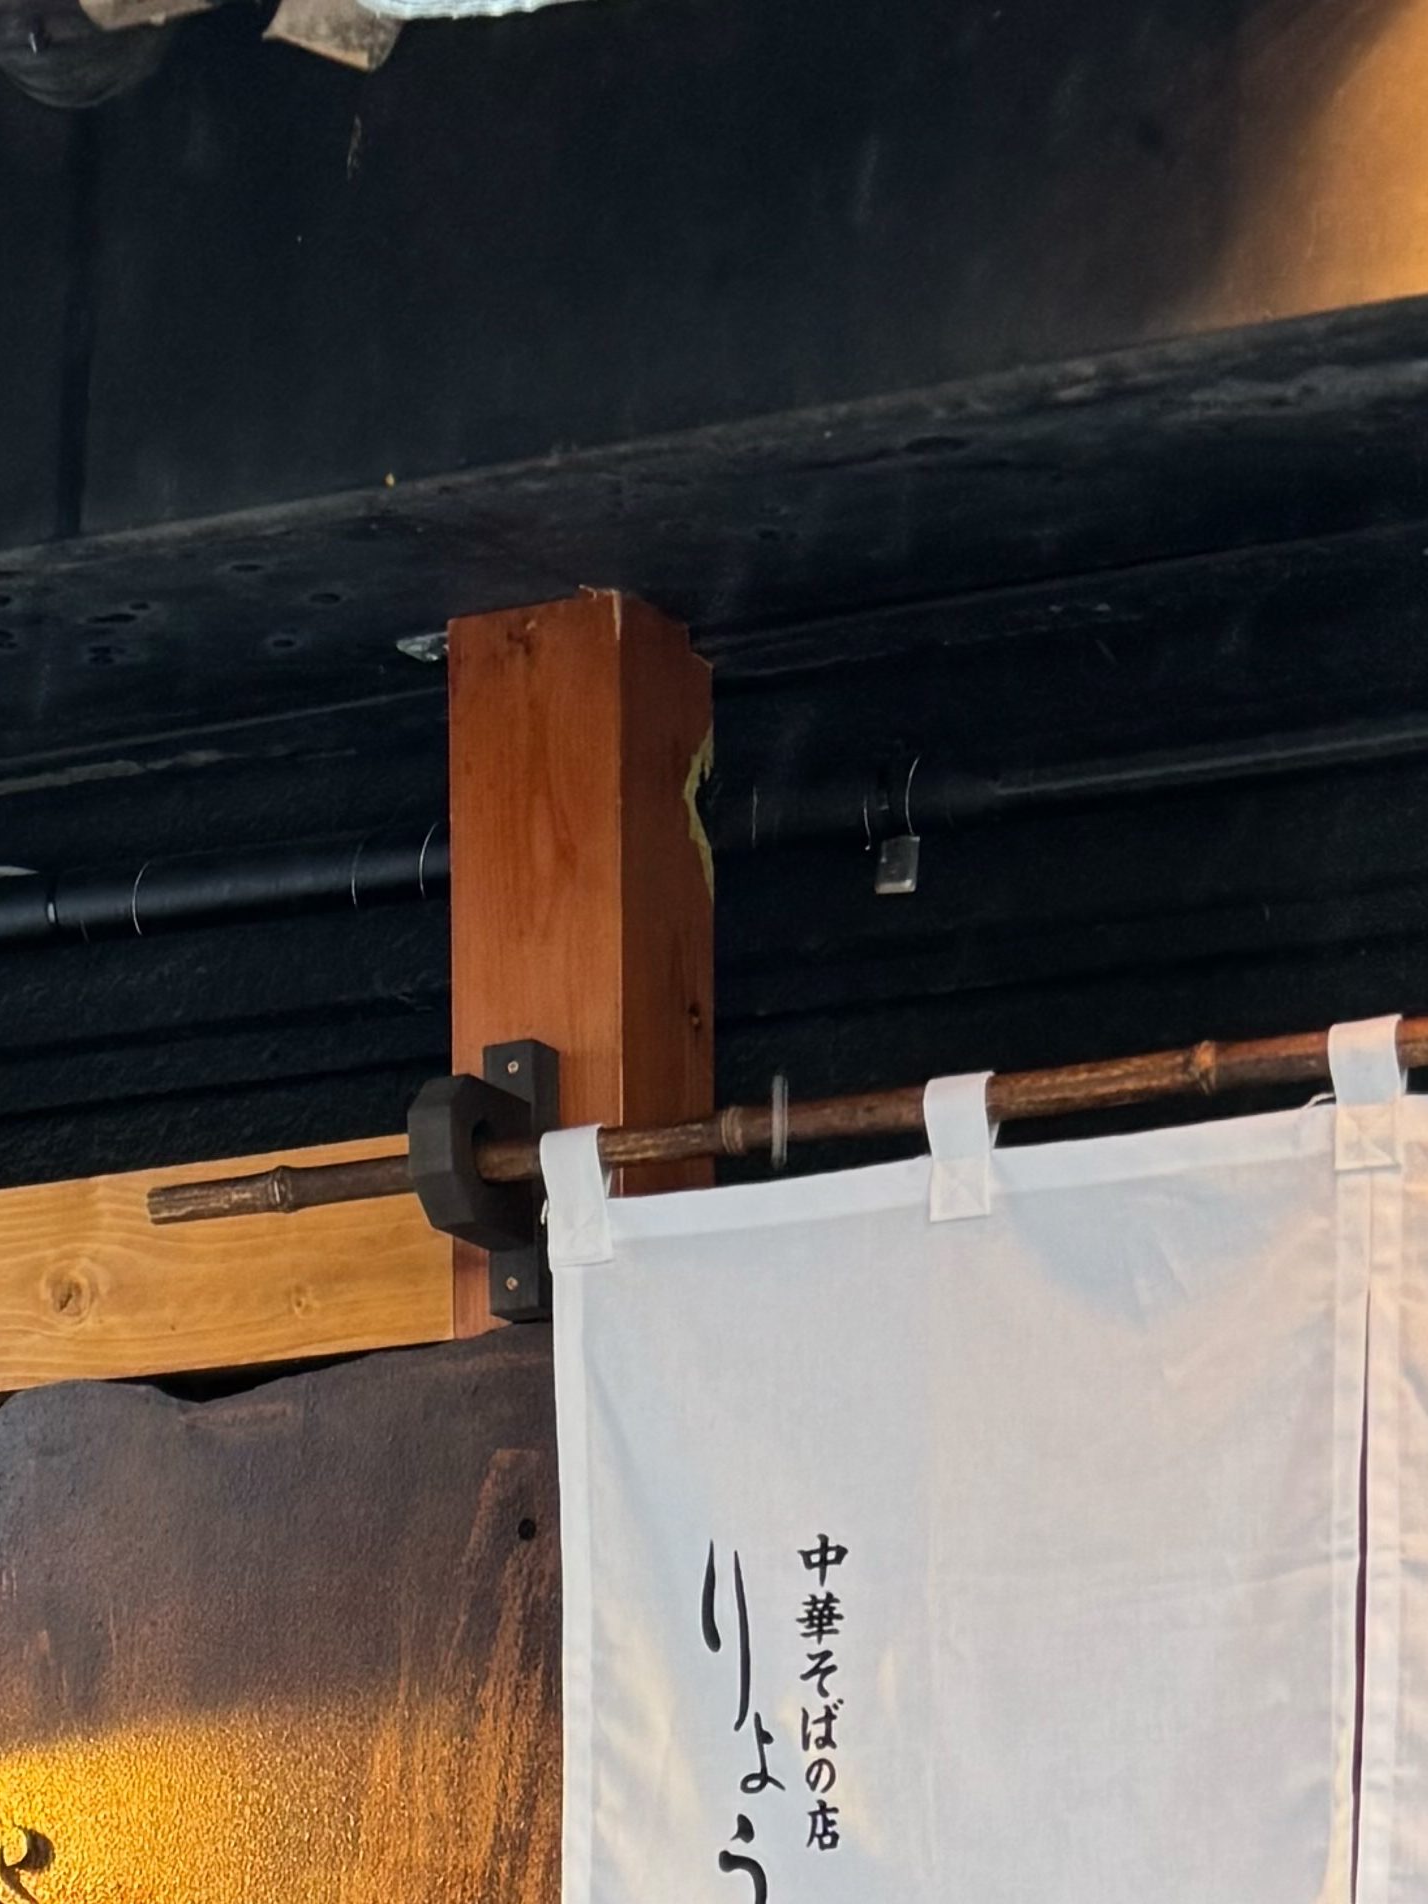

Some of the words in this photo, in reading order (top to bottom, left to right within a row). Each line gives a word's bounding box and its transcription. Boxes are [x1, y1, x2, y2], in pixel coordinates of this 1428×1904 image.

[795, 1533, 849, 1851] 中華そばの店
